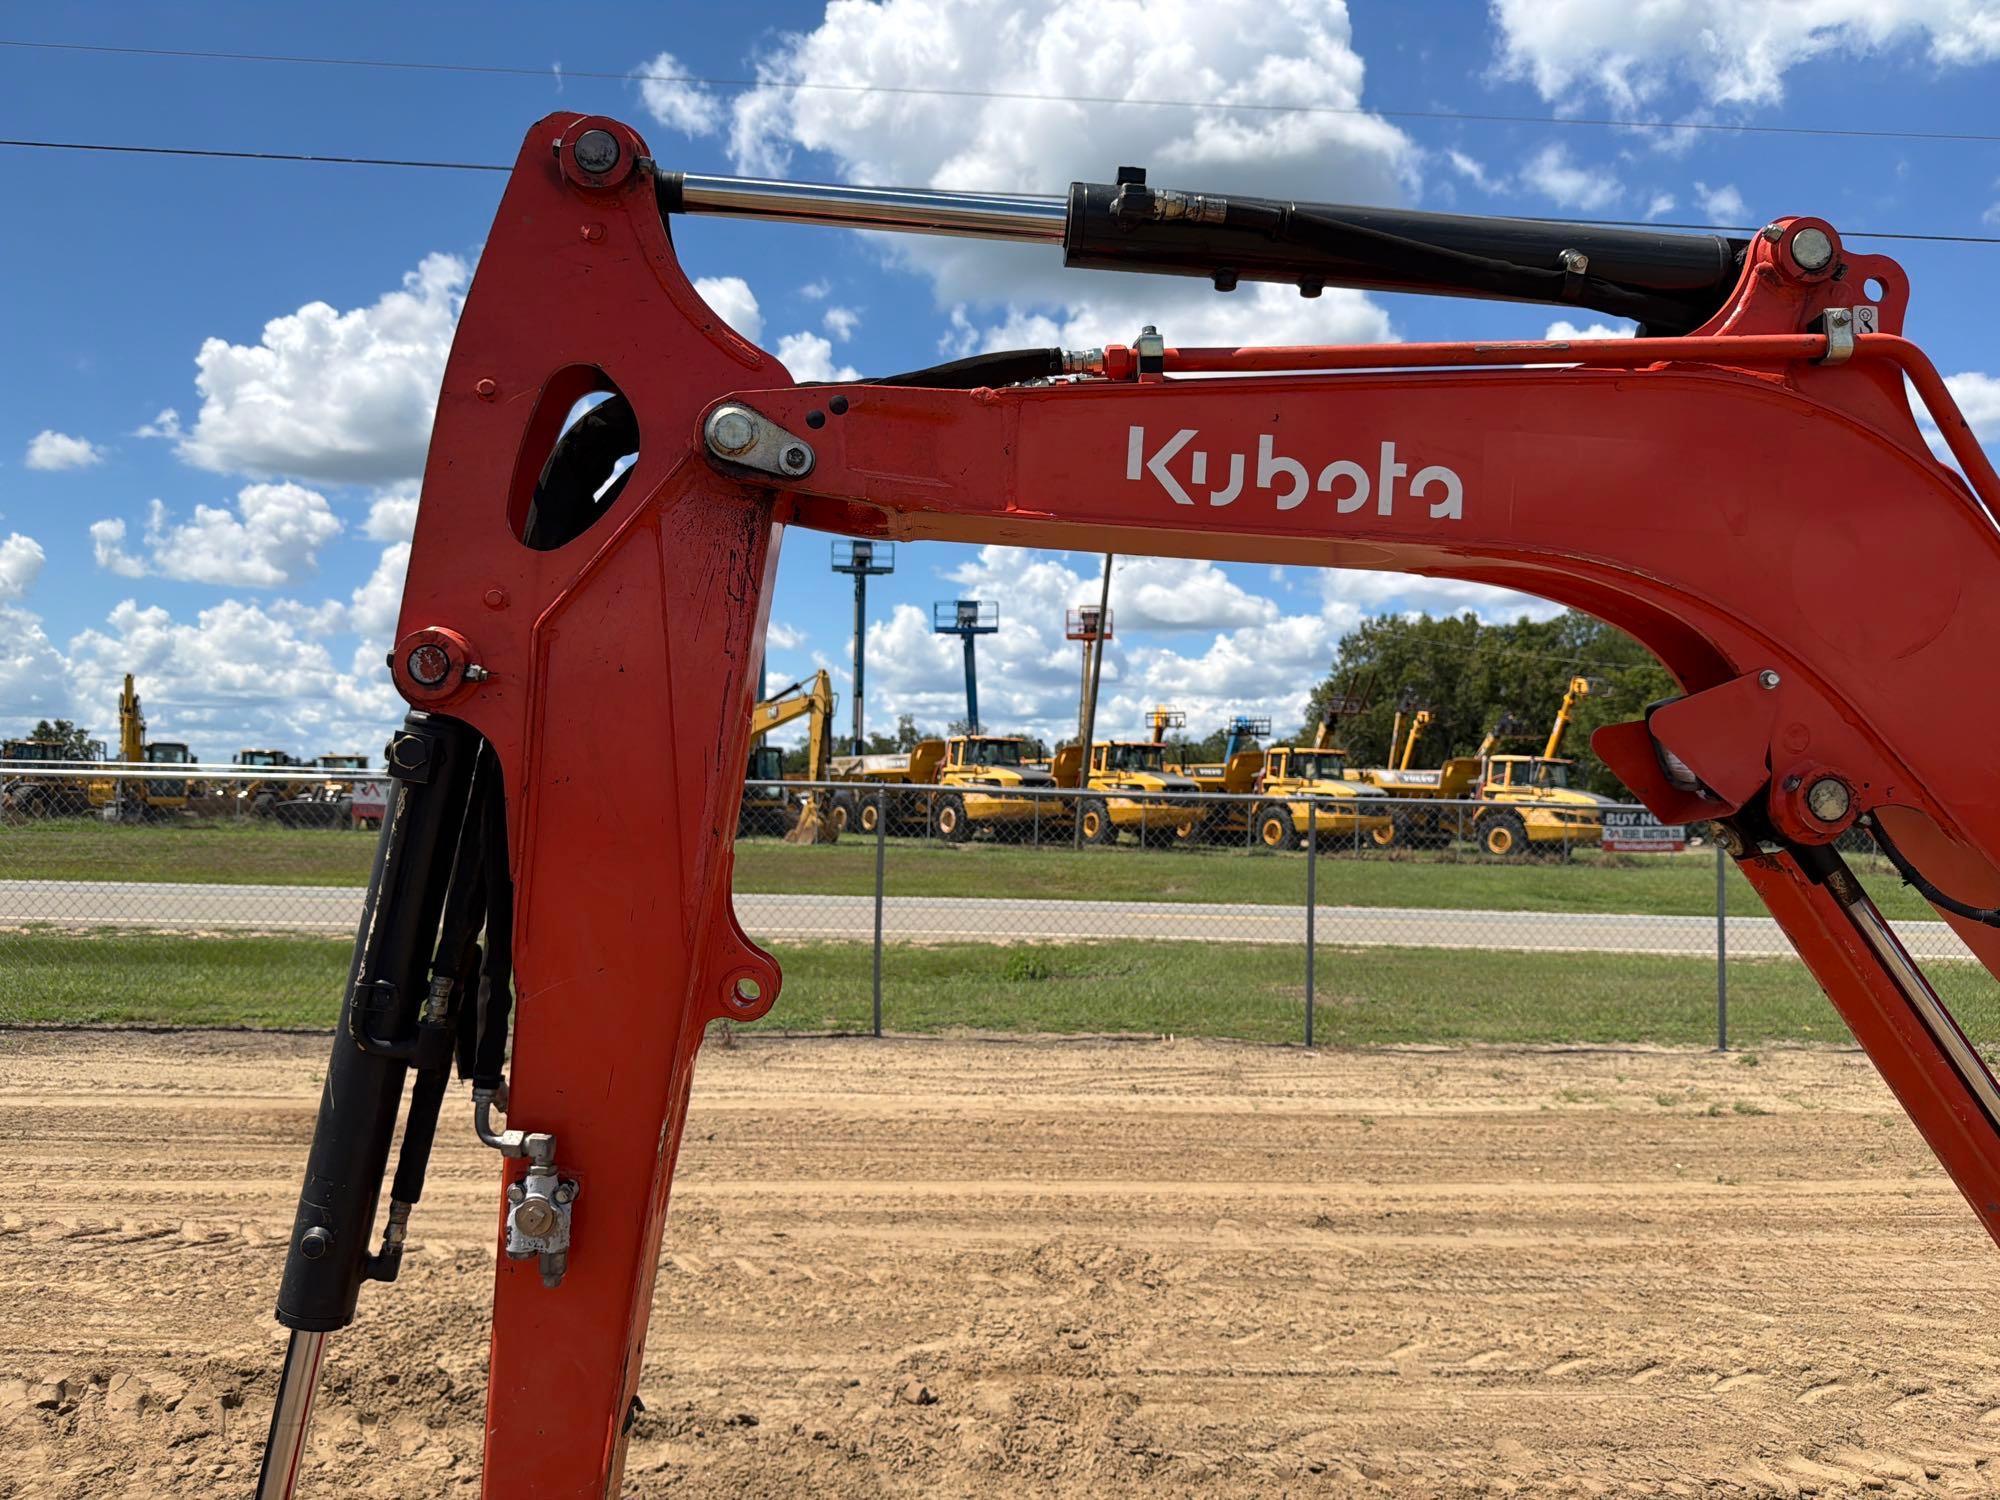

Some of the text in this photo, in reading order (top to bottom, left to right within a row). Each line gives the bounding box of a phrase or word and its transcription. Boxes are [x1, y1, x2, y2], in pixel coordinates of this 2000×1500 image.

[1126, 425, 1463, 520] Kubota
[1403, 775, 1436, 783] VOLVO
[1606, 813, 1637, 825] BUY
